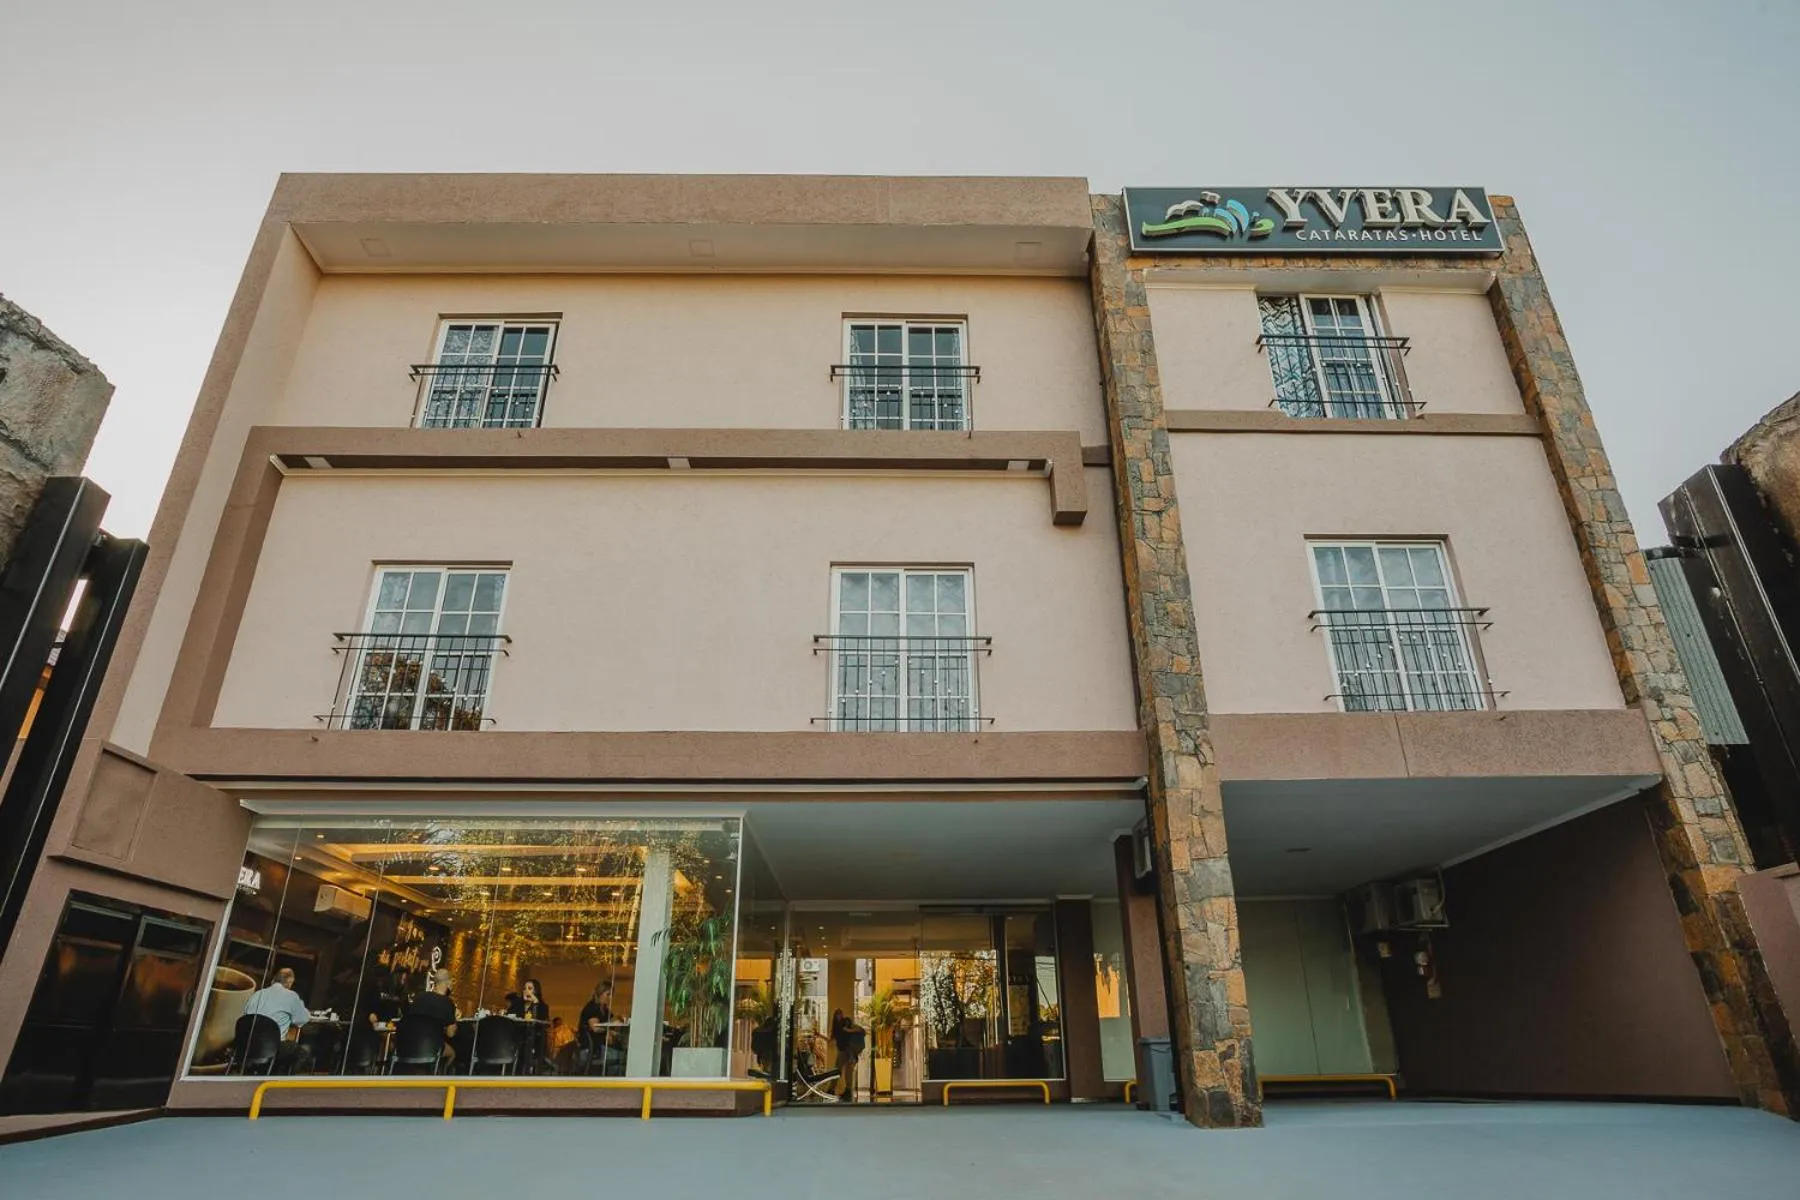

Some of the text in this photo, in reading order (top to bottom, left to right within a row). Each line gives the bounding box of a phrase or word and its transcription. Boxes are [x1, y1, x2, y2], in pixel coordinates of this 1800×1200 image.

[1267, 189, 1491, 227] YVERA
[1295, 229, 1483, 241] CATARATAS HOTEL
